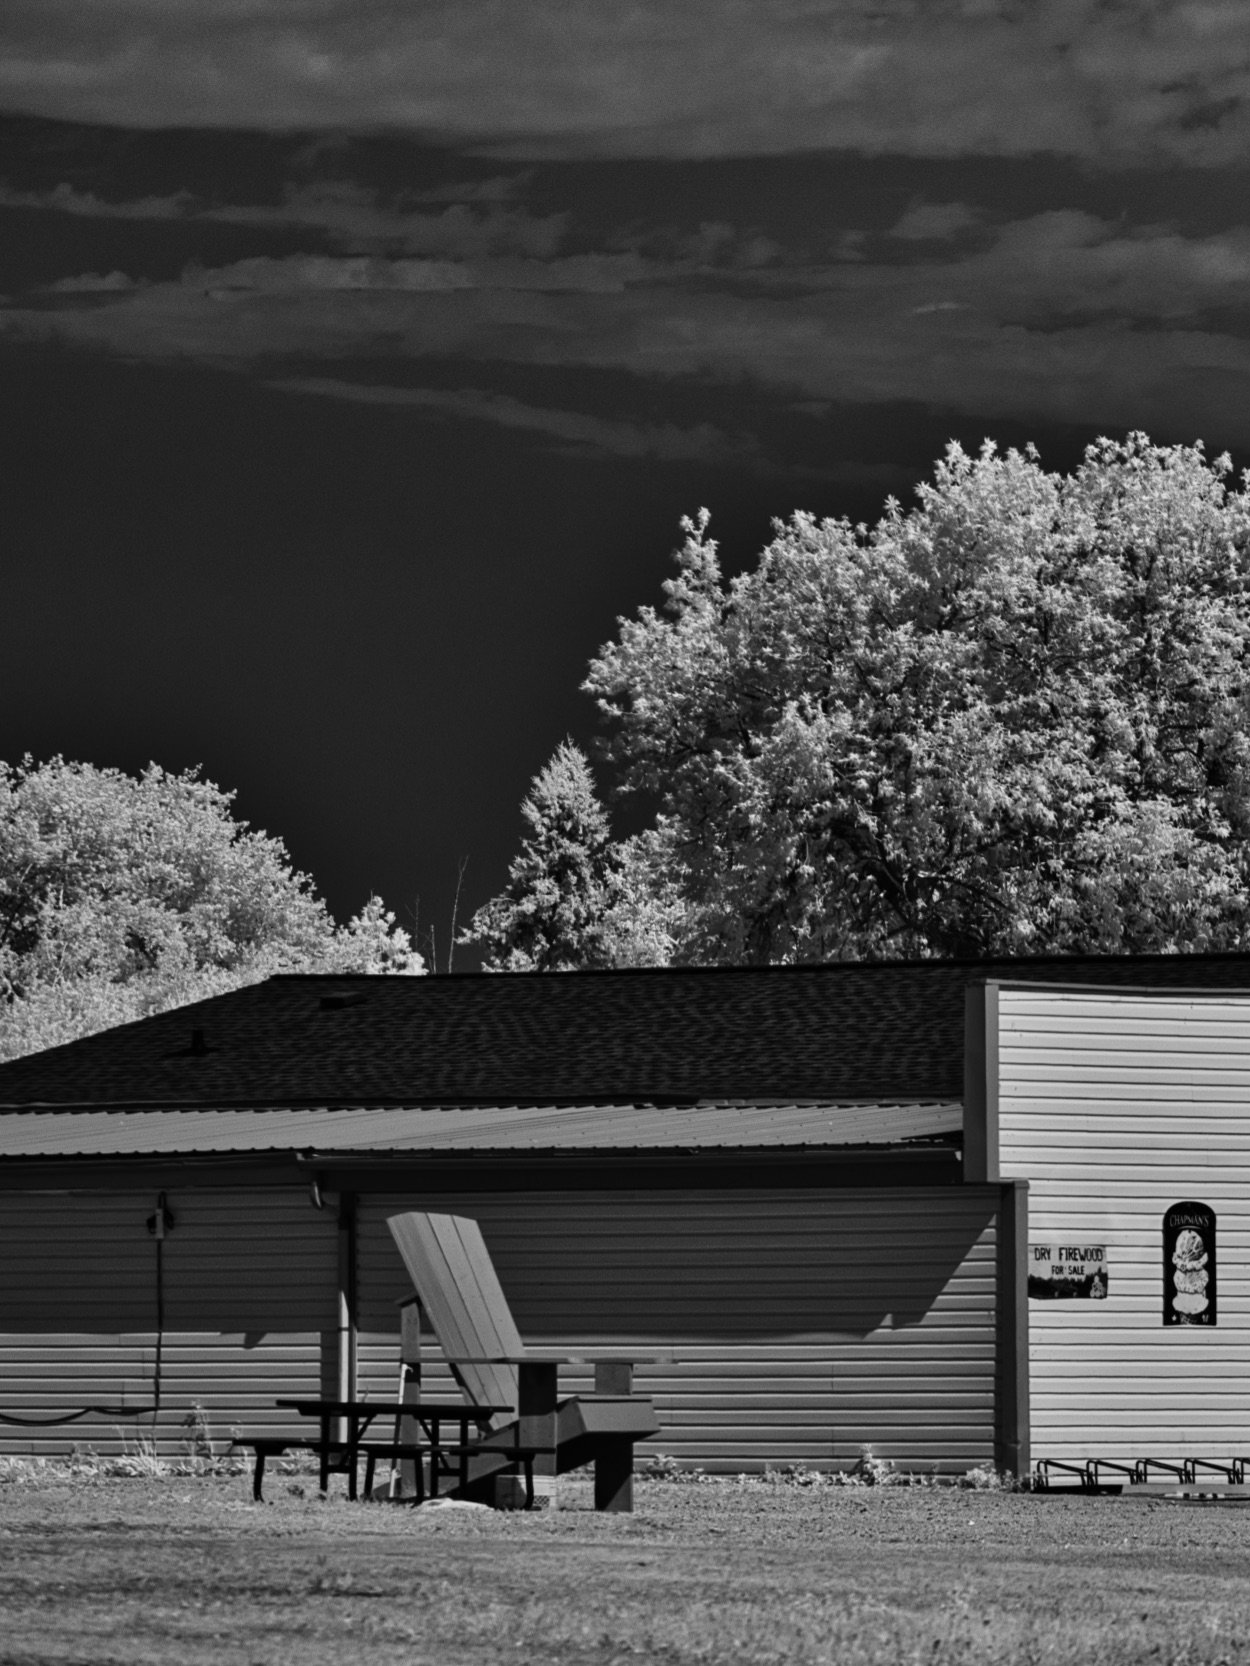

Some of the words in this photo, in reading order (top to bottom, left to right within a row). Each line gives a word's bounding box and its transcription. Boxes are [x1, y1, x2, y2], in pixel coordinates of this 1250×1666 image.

[1169, 1214, 1210, 1227] CHAPMAN'S
[1034, 1247, 1051, 1261] DRY
[1058, 1247, 1103, 1261] FIREWOOD
[1051, 1265, 1064, 1275] FOR
[1068, 1265, 1085, 1275] SALE
